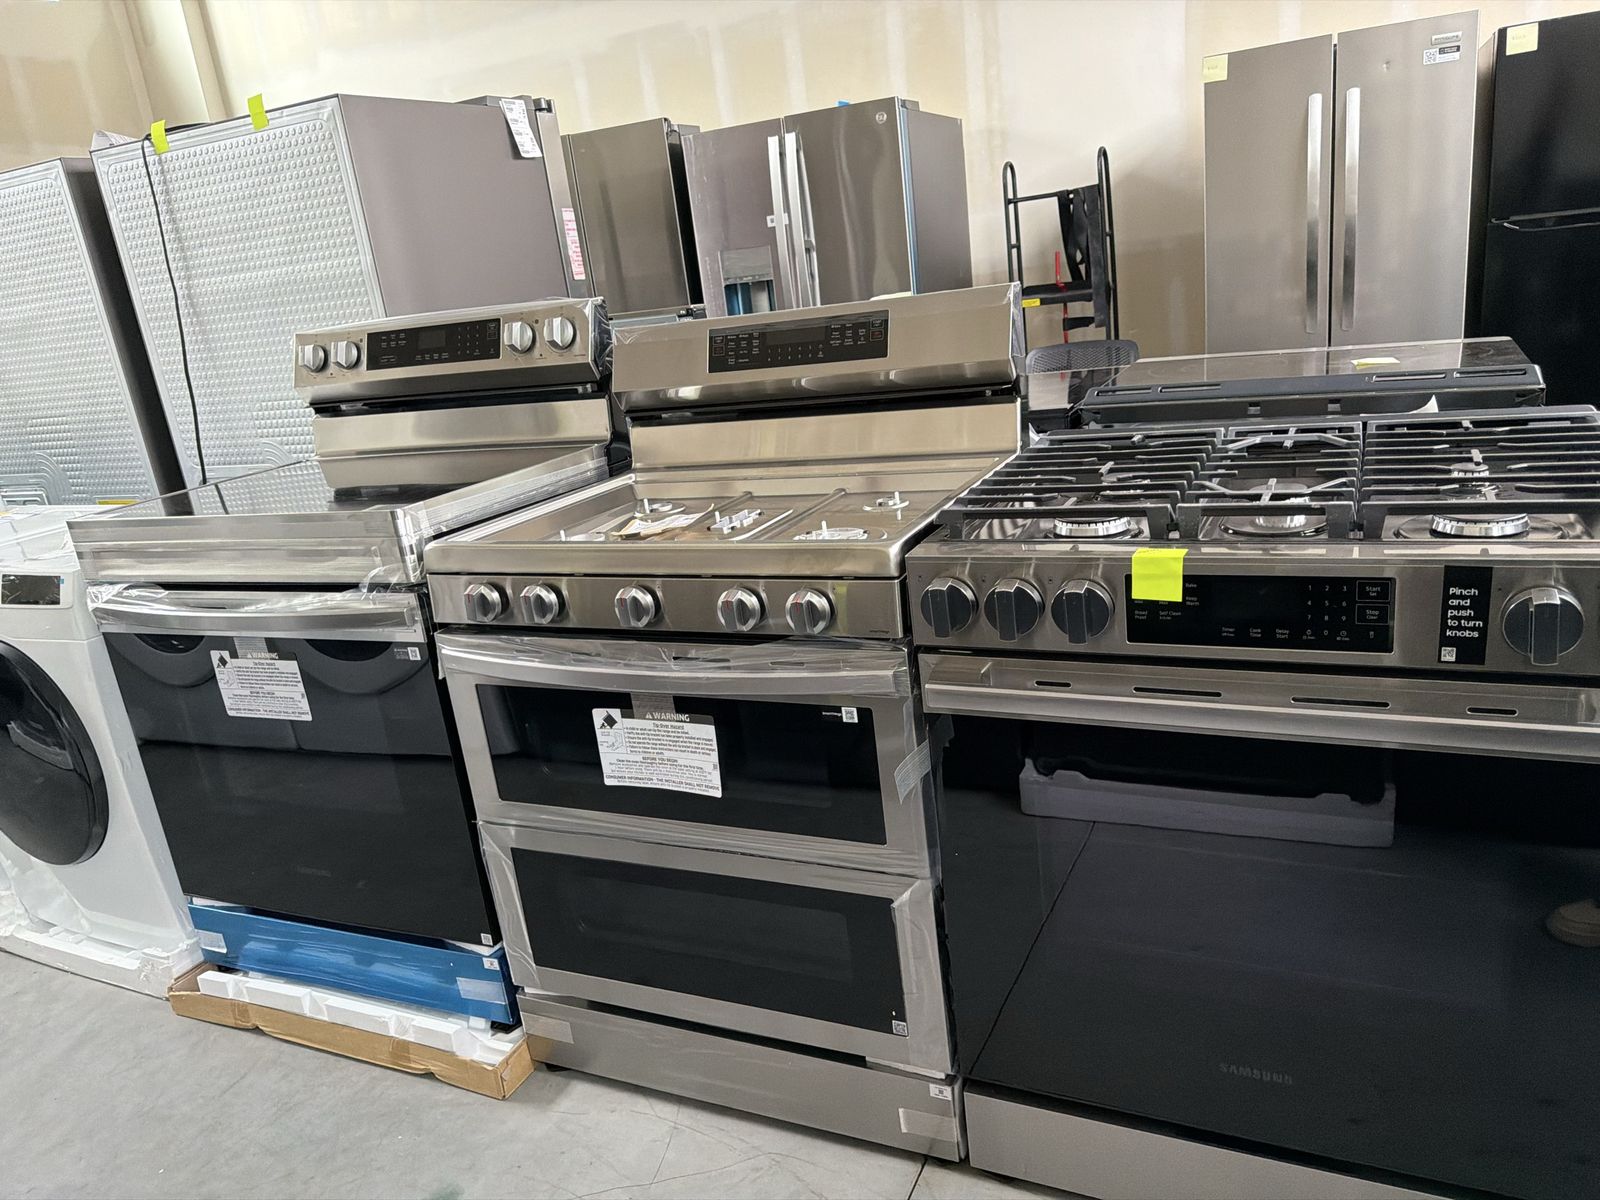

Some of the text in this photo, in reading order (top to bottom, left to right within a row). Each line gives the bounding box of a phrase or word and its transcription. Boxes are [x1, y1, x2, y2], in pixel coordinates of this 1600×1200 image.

[1449, 587, 1478, 596] Pinch
[1448, 598, 1471, 606] and
[1447, 608, 1474, 618] push
[1447, 619, 1483, 627] to turn
[1446, 629, 1479, 638] knobs
[251, 652, 279, 660] WARNING
[652, 711, 690, 722] WARNING
